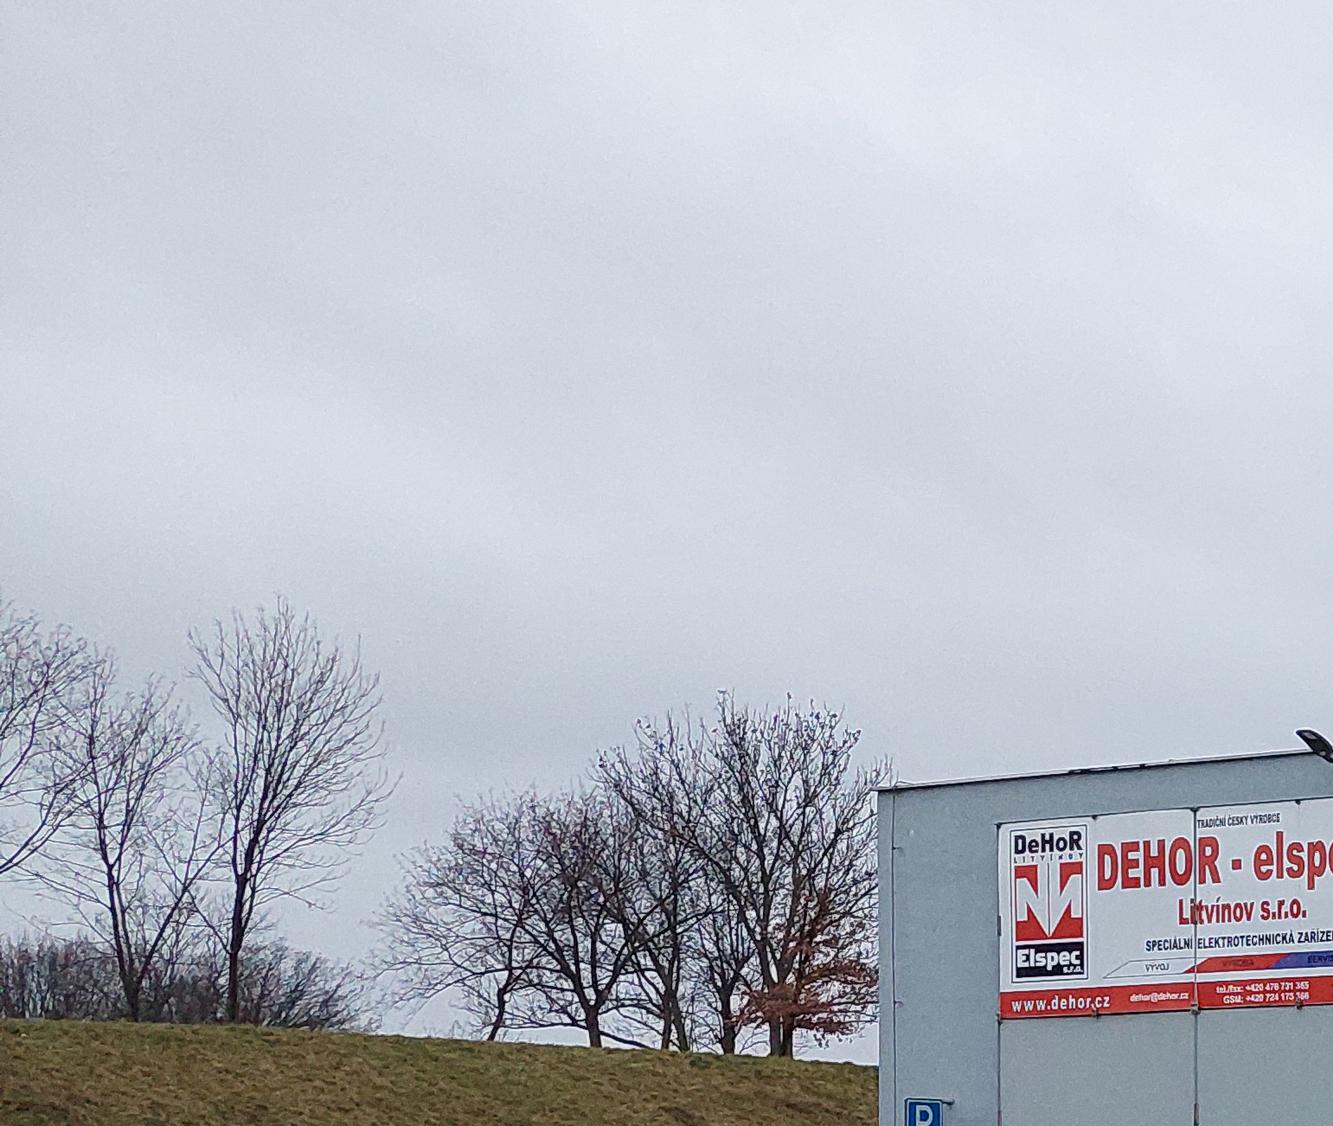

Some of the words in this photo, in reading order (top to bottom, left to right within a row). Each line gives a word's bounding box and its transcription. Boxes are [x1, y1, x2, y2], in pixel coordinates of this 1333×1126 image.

[1014, 831, 1082, 855] DeHoR
[1097, 836, 1222, 892] DEHOR
[1178, 897, 1254, 926] Litvínov
[1260, 898, 1307, 921] s.r.o.
[1145, 935, 1193, 952] SPECIÁLNÍ
[1197, 929, 1295, 949] ELEKTROTECHNICKÁ
[1017, 949, 1081, 970] Elspec
[1012, 995, 1110, 1013] www.dehor.cz
